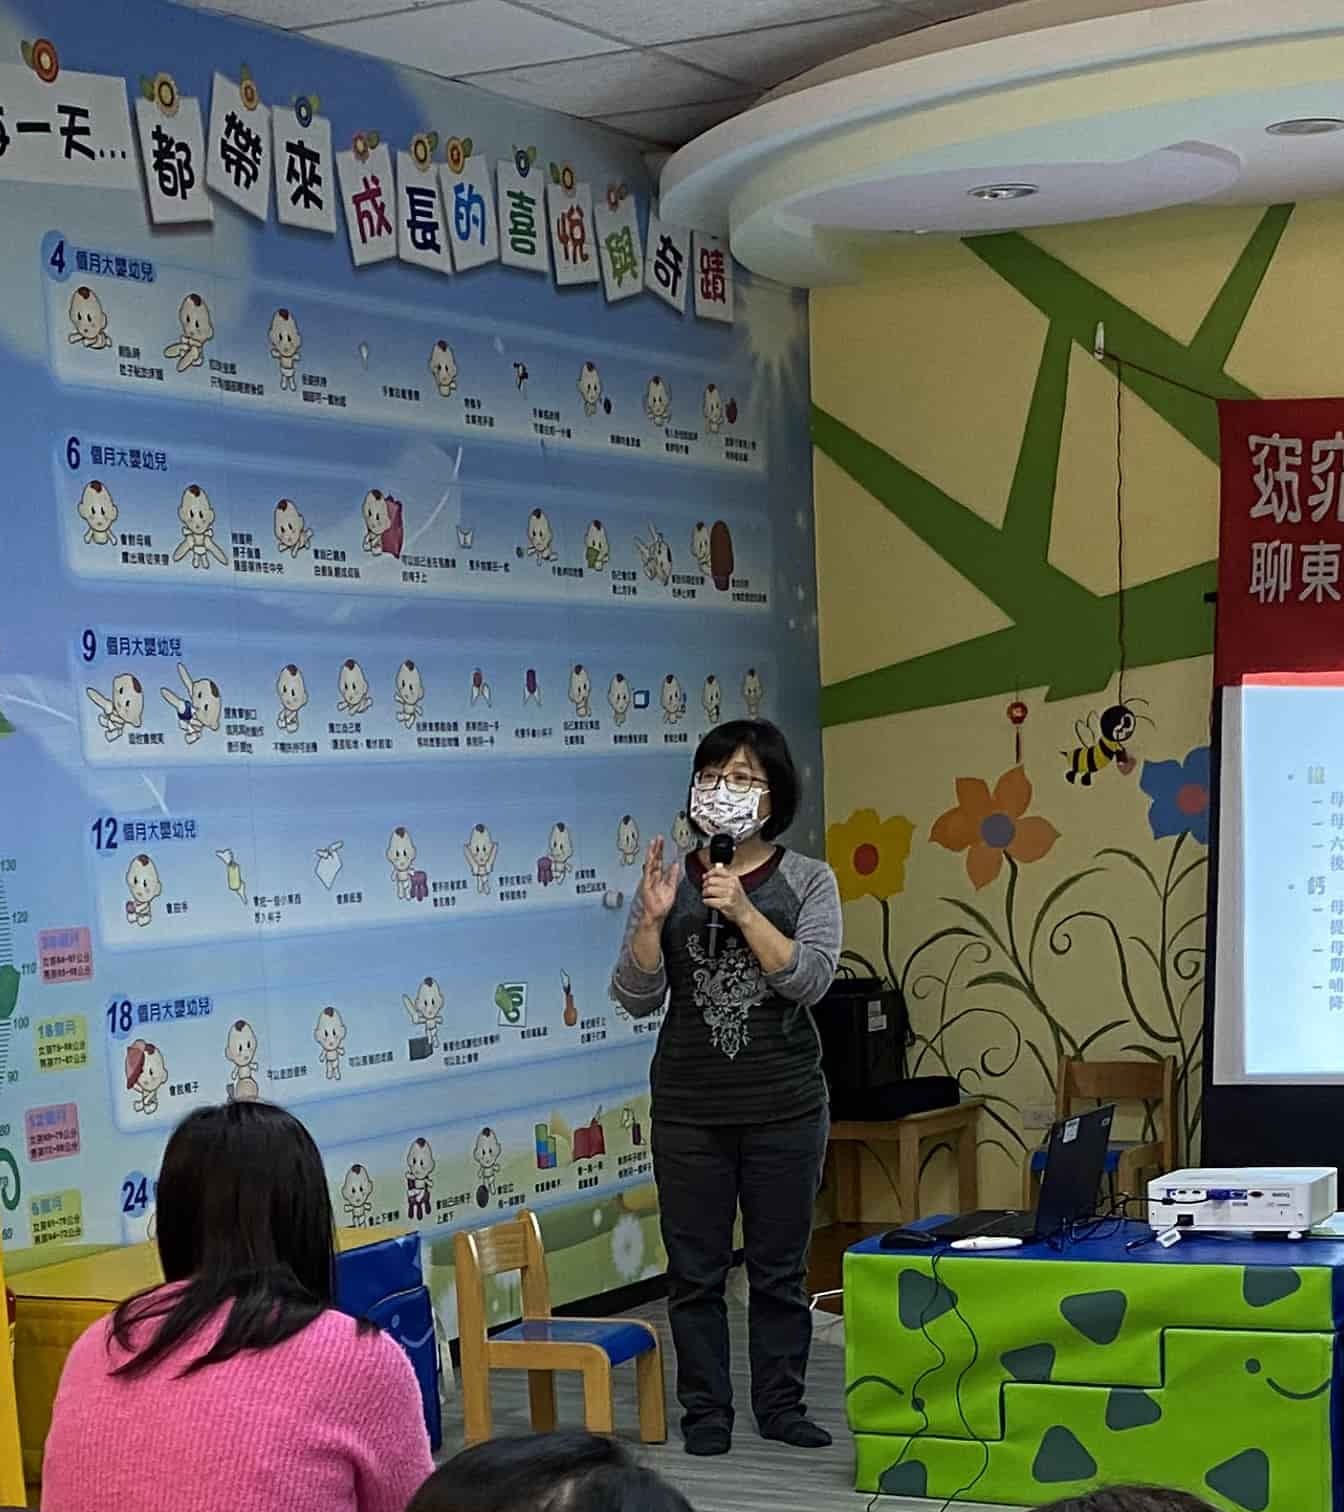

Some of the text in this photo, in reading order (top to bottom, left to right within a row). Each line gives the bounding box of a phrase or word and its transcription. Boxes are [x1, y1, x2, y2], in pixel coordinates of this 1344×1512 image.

[50, 240, 66, 274] 4
[66, 436, 168, 472] 6 個月大嬰幼兒
[82, 628, 183, 662] 9 個月大嬰幼兒
[92, 817, 197, 850] 12 個月大嬰幼兒
[106, 996, 211, 1033] 18 個月大嬰幼兒
[122, 1177, 148, 1213] 24
